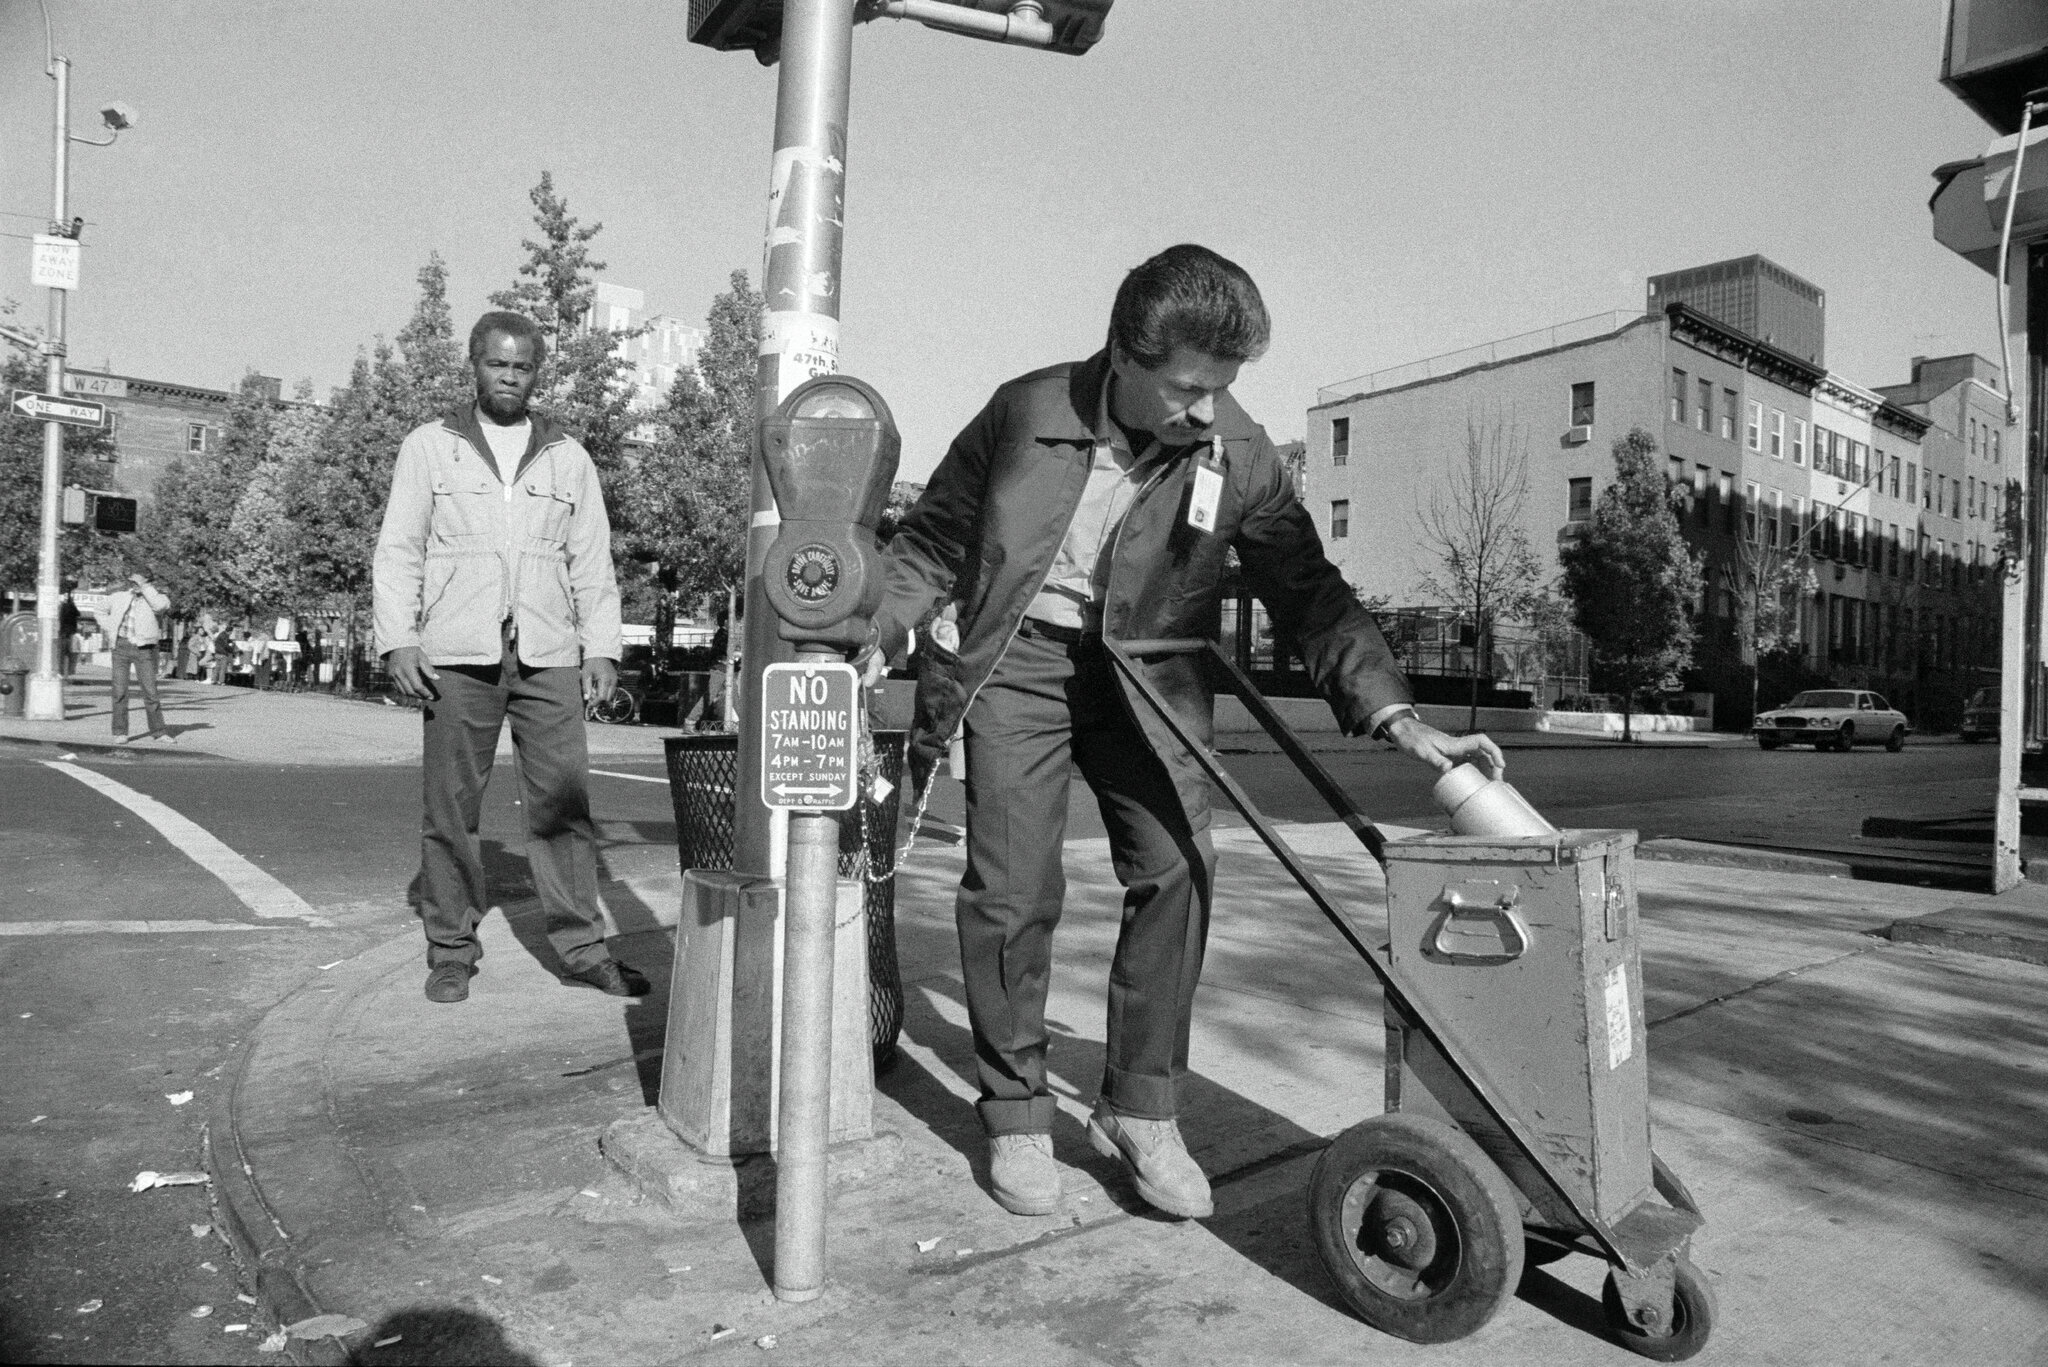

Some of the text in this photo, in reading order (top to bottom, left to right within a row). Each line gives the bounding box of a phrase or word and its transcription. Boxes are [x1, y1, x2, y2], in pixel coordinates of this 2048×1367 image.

[39, 254, 75, 267] AWAY
[38, 266, 74, 281] ZONE
[74, 377, 86, 391] W
[90, 380, 109, 393] 47
[26, 400, 95, 418] ONE WAY
[793, 579, 810, 596] SAVE
[810, 587, 817, 597] A
[789, 675, 828, 705] NO
[770, 710, 847, 731] STANDING
[769, 772, 847, 781] EXCEPT SUNDAY
